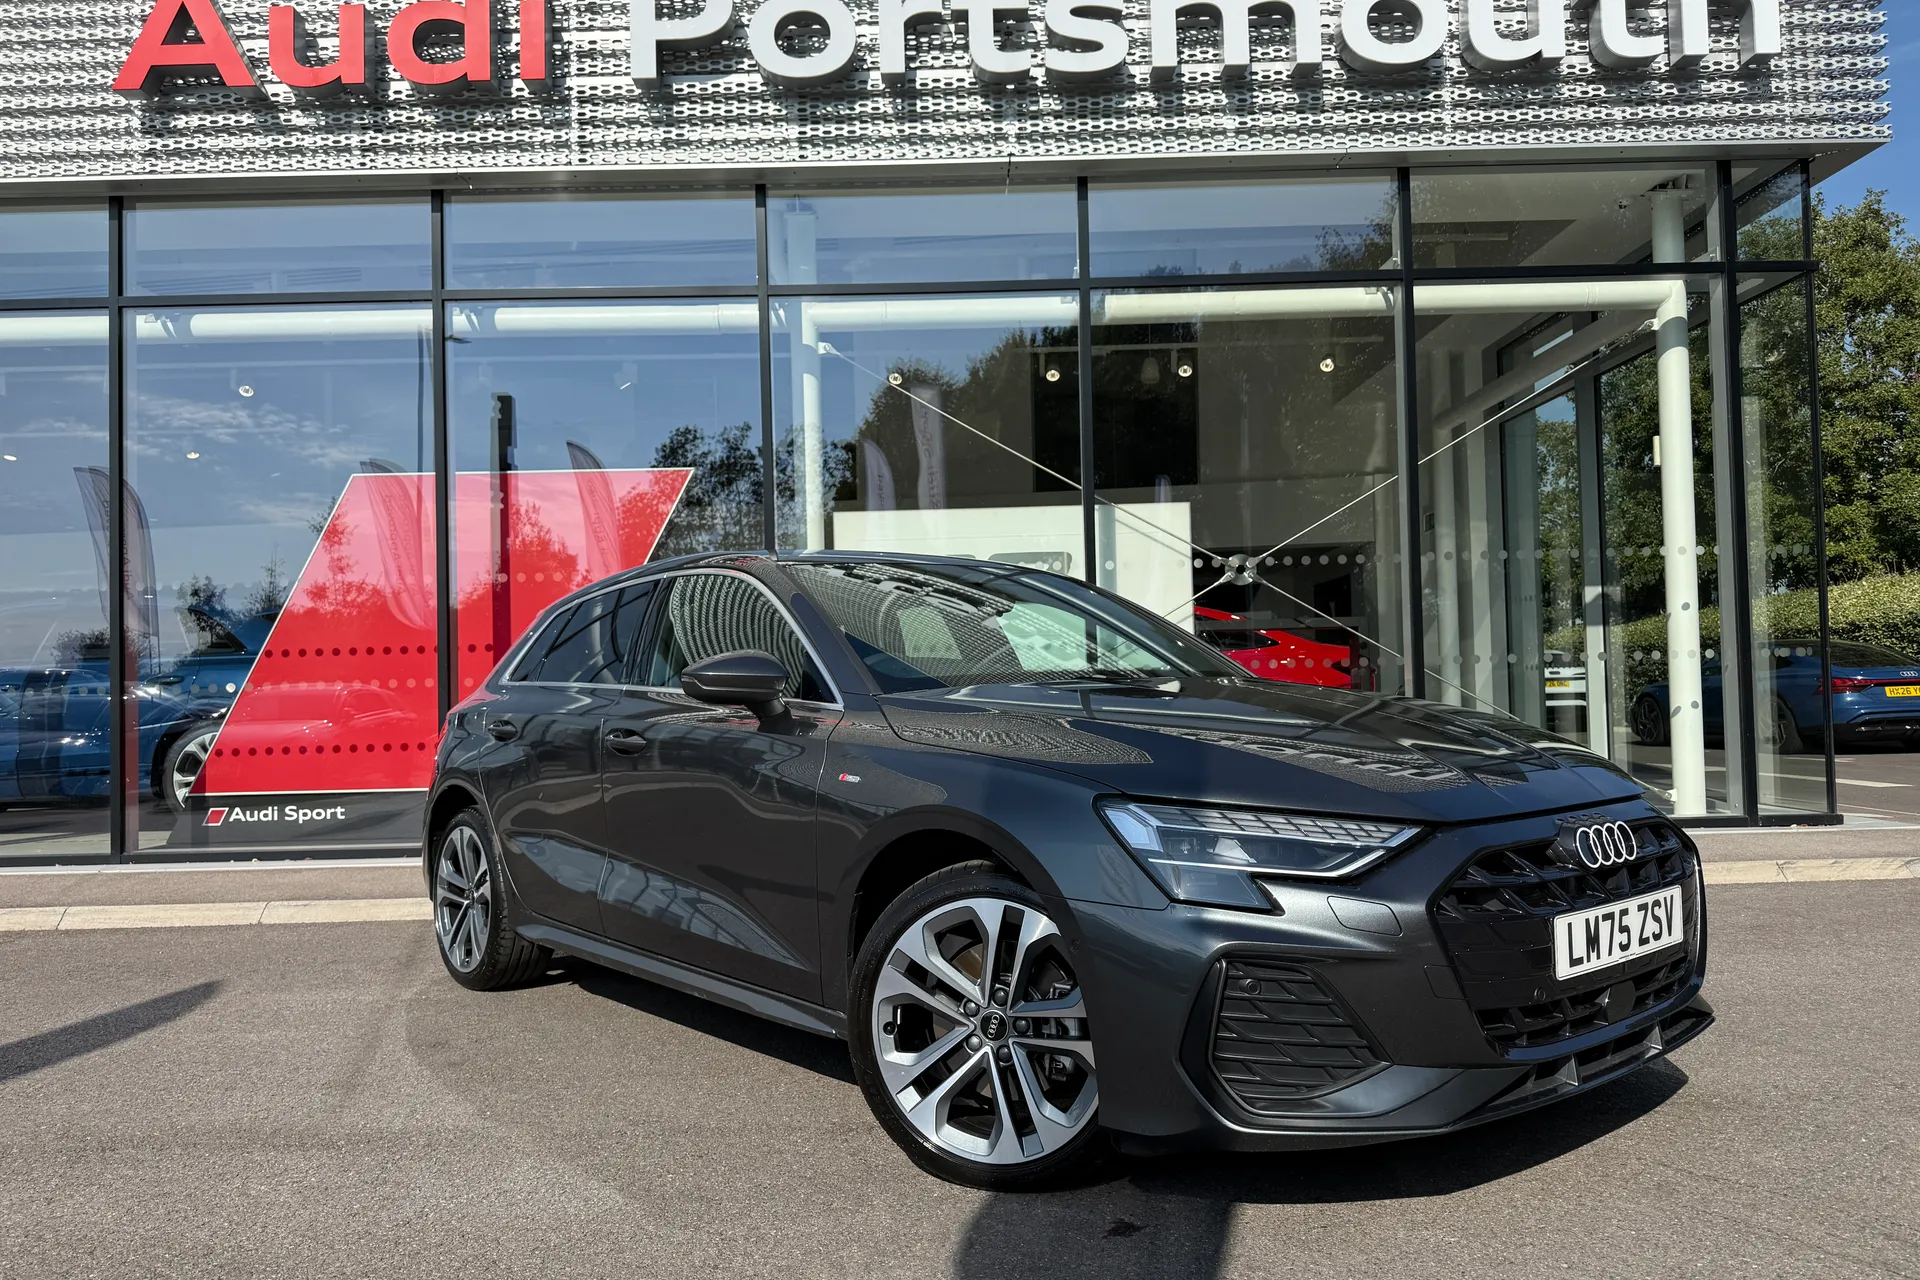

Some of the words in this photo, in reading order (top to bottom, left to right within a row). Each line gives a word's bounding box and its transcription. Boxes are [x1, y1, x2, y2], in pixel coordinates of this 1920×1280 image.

[112, 0, 547, 91] Audi
[229, 806, 278, 822] Audi
[284, 805, 346, 824] Sport
[1567, 907, 1631, 968] LM75
[1637, 894, 1674, 948] ZSV
